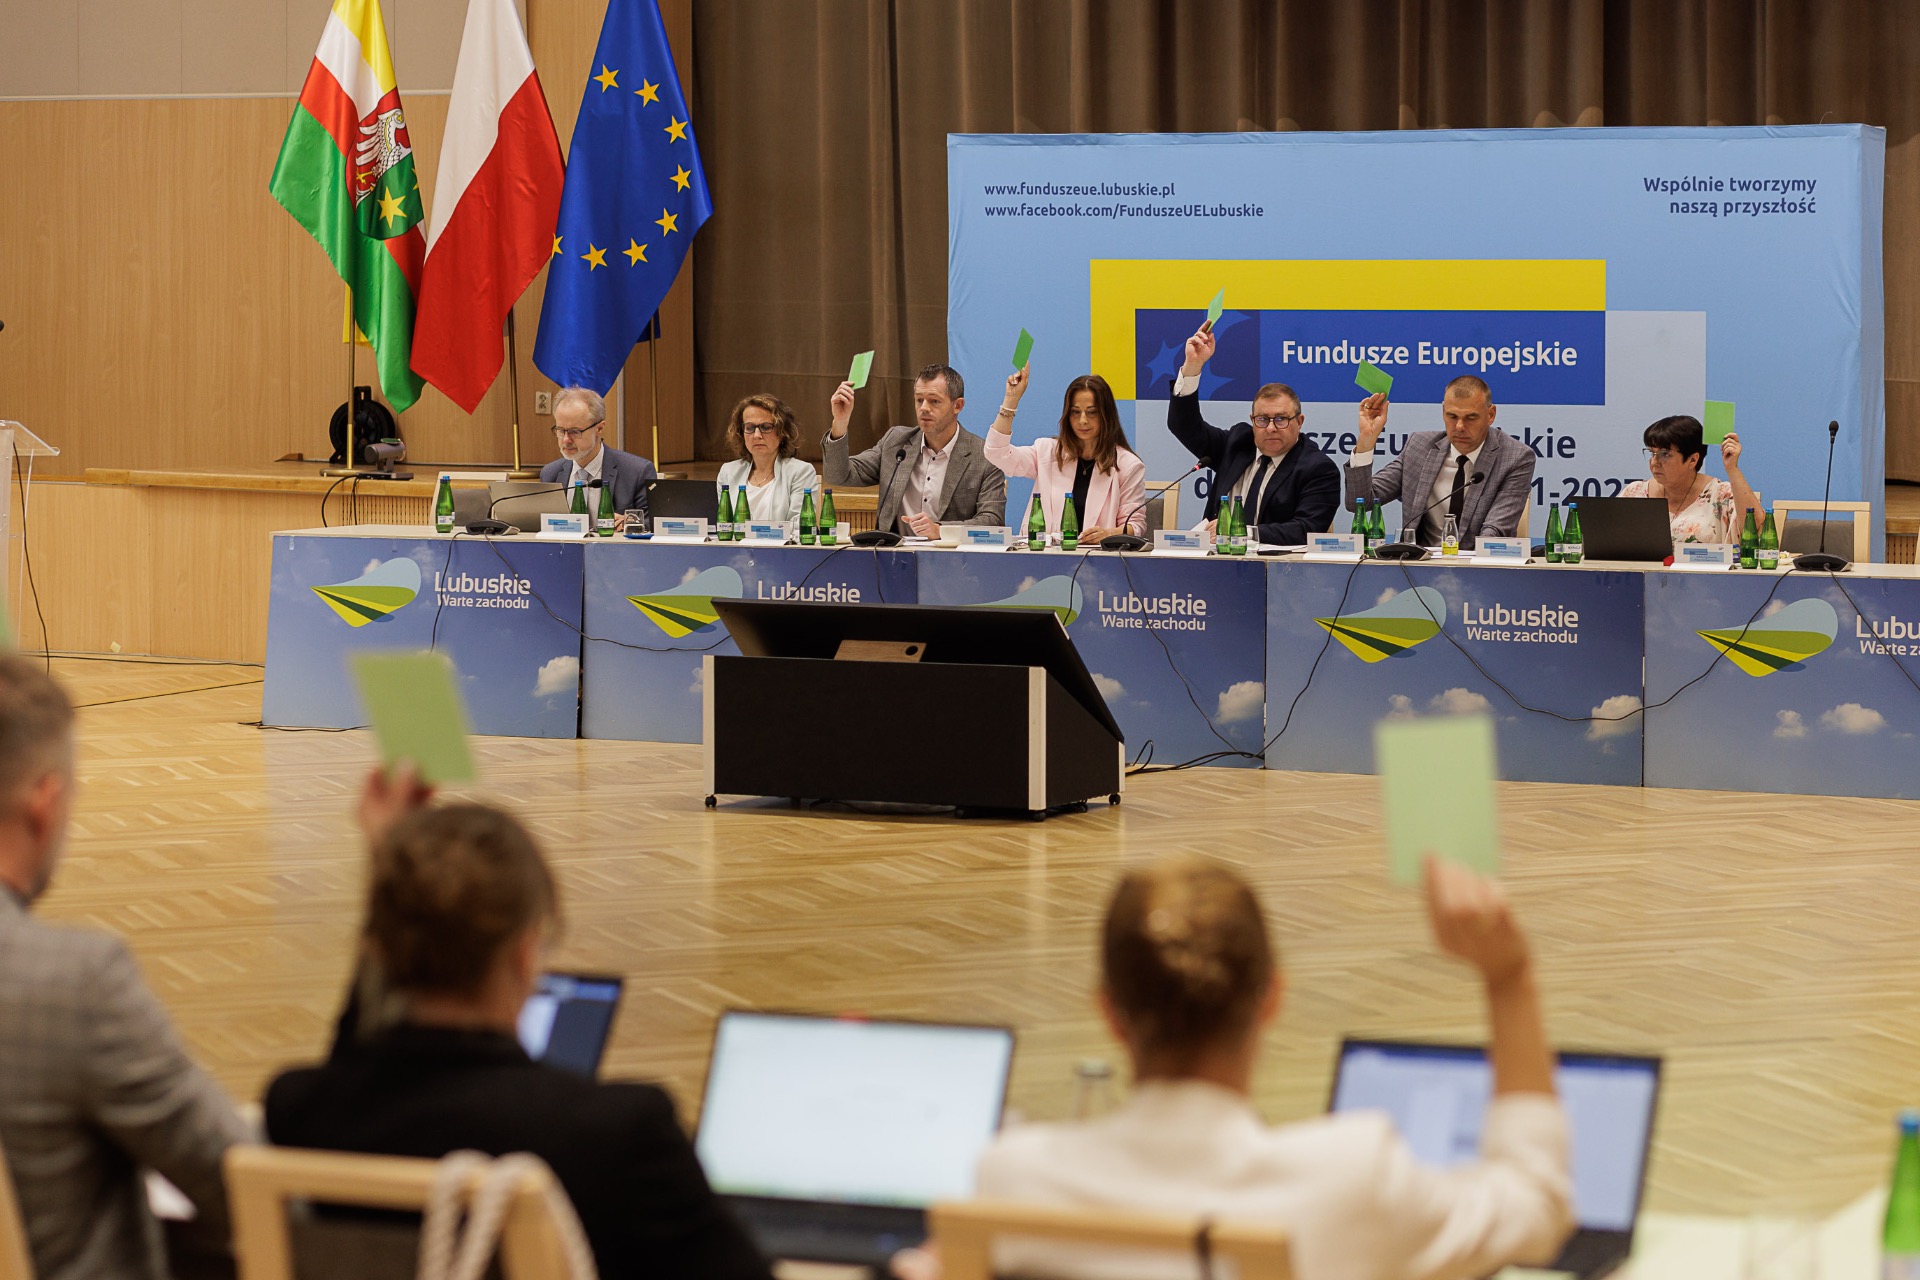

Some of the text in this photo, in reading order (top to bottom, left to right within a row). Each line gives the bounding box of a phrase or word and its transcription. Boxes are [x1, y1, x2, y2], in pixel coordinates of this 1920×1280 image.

[984, 182, 1176, 198] www.funduszeue.lubuskie.pl
[1643, 176, 1817, 195] Wspólnie tworzymy
[984, 204, 1264, 219] www.facebook.com/FunduszeUELubuskie
[1670, 197, 1816, 217] naszą przyszłość
[1282, 340, 1578, 372] Fundusze Europejskie
[434, 571, 531, 595] Lubuskie
[757, 580, 861, 603] Lubuskie
[437, 594, 530, 609] Warte zachodu
[1098, 590, 1207, 616] Lubuskie
[1101, 614, 1206, 631] Warte zachodu
[1463, 602, 1579, 628] Lubuskie
[1466, 627, 1578, 644] Warte zachodu
[1860, 640, 1907, 655] Warte
